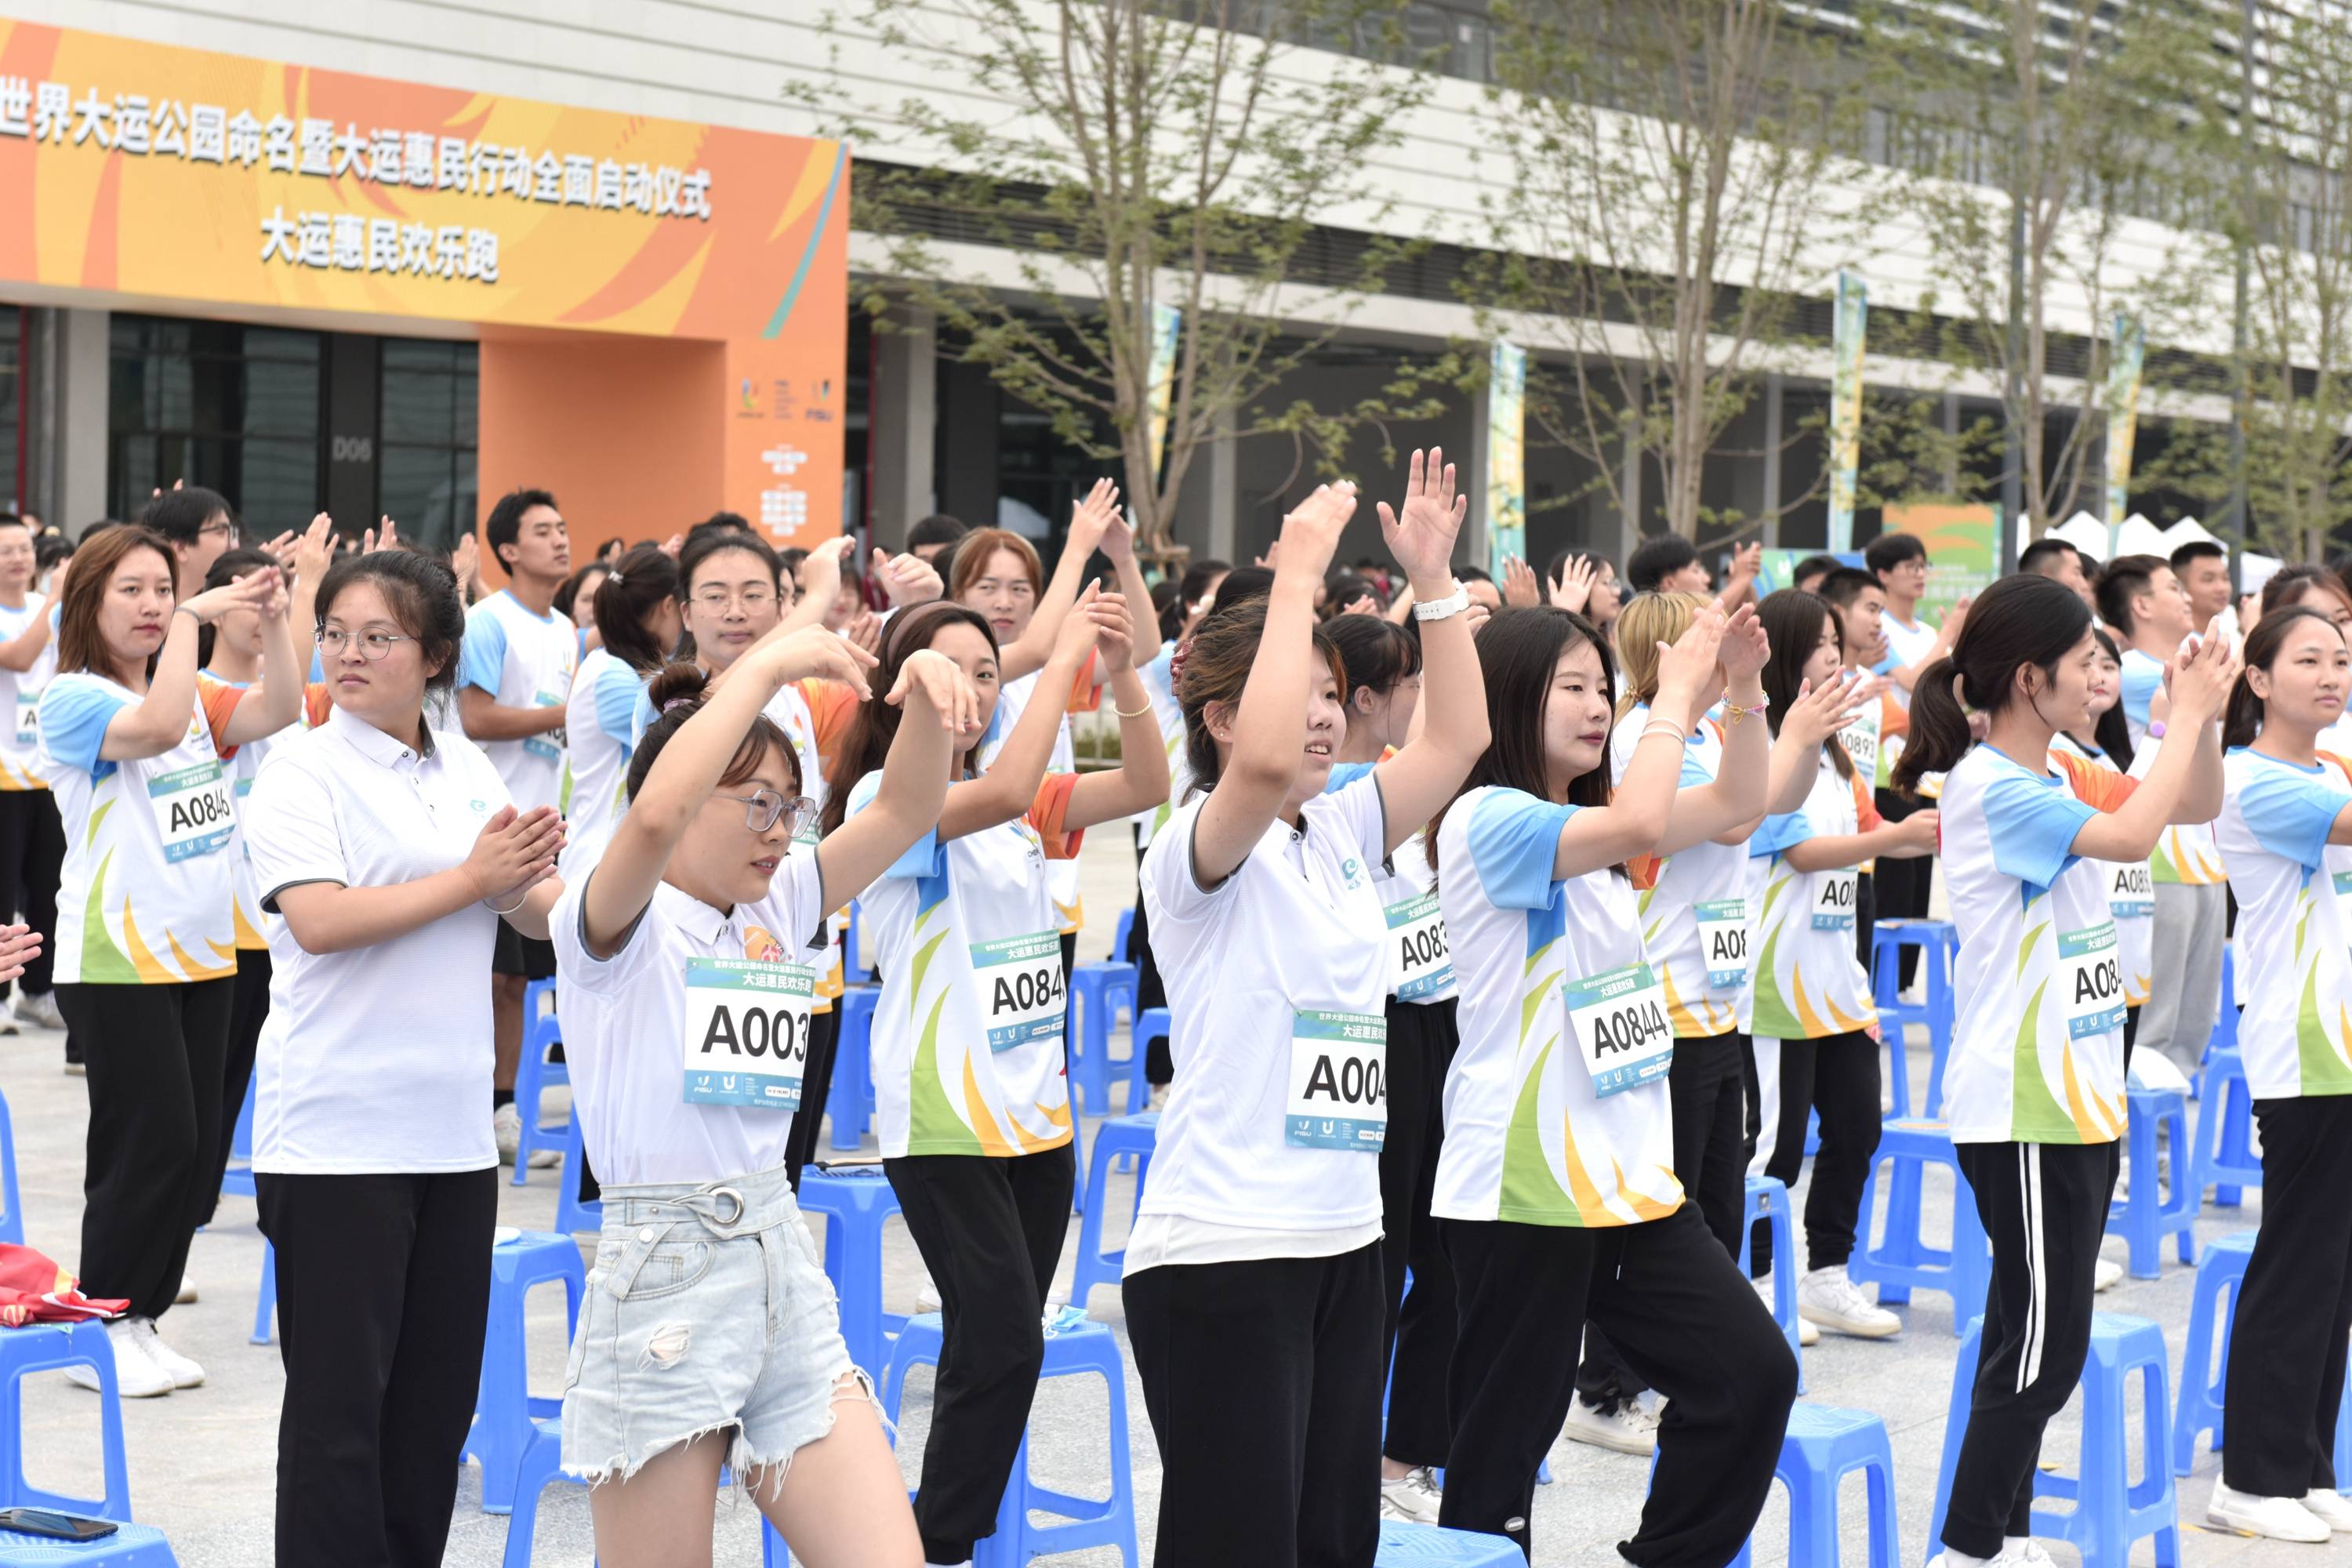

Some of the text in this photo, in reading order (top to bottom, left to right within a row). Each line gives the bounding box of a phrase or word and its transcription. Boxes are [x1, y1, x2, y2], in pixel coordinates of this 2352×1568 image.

[0, 74, 711, 220] 世界大运公园命名暨大运惠民行动全面启动仪式
[261, 205, 499, 282] 大运惠民欢乐跑
[171, 788, 230, 833] A0846
[993, 964, 1065, 1015] A084
[701, 1004, 809, 1062] A003
[1595, 1000, 1668, 1059] A0844
